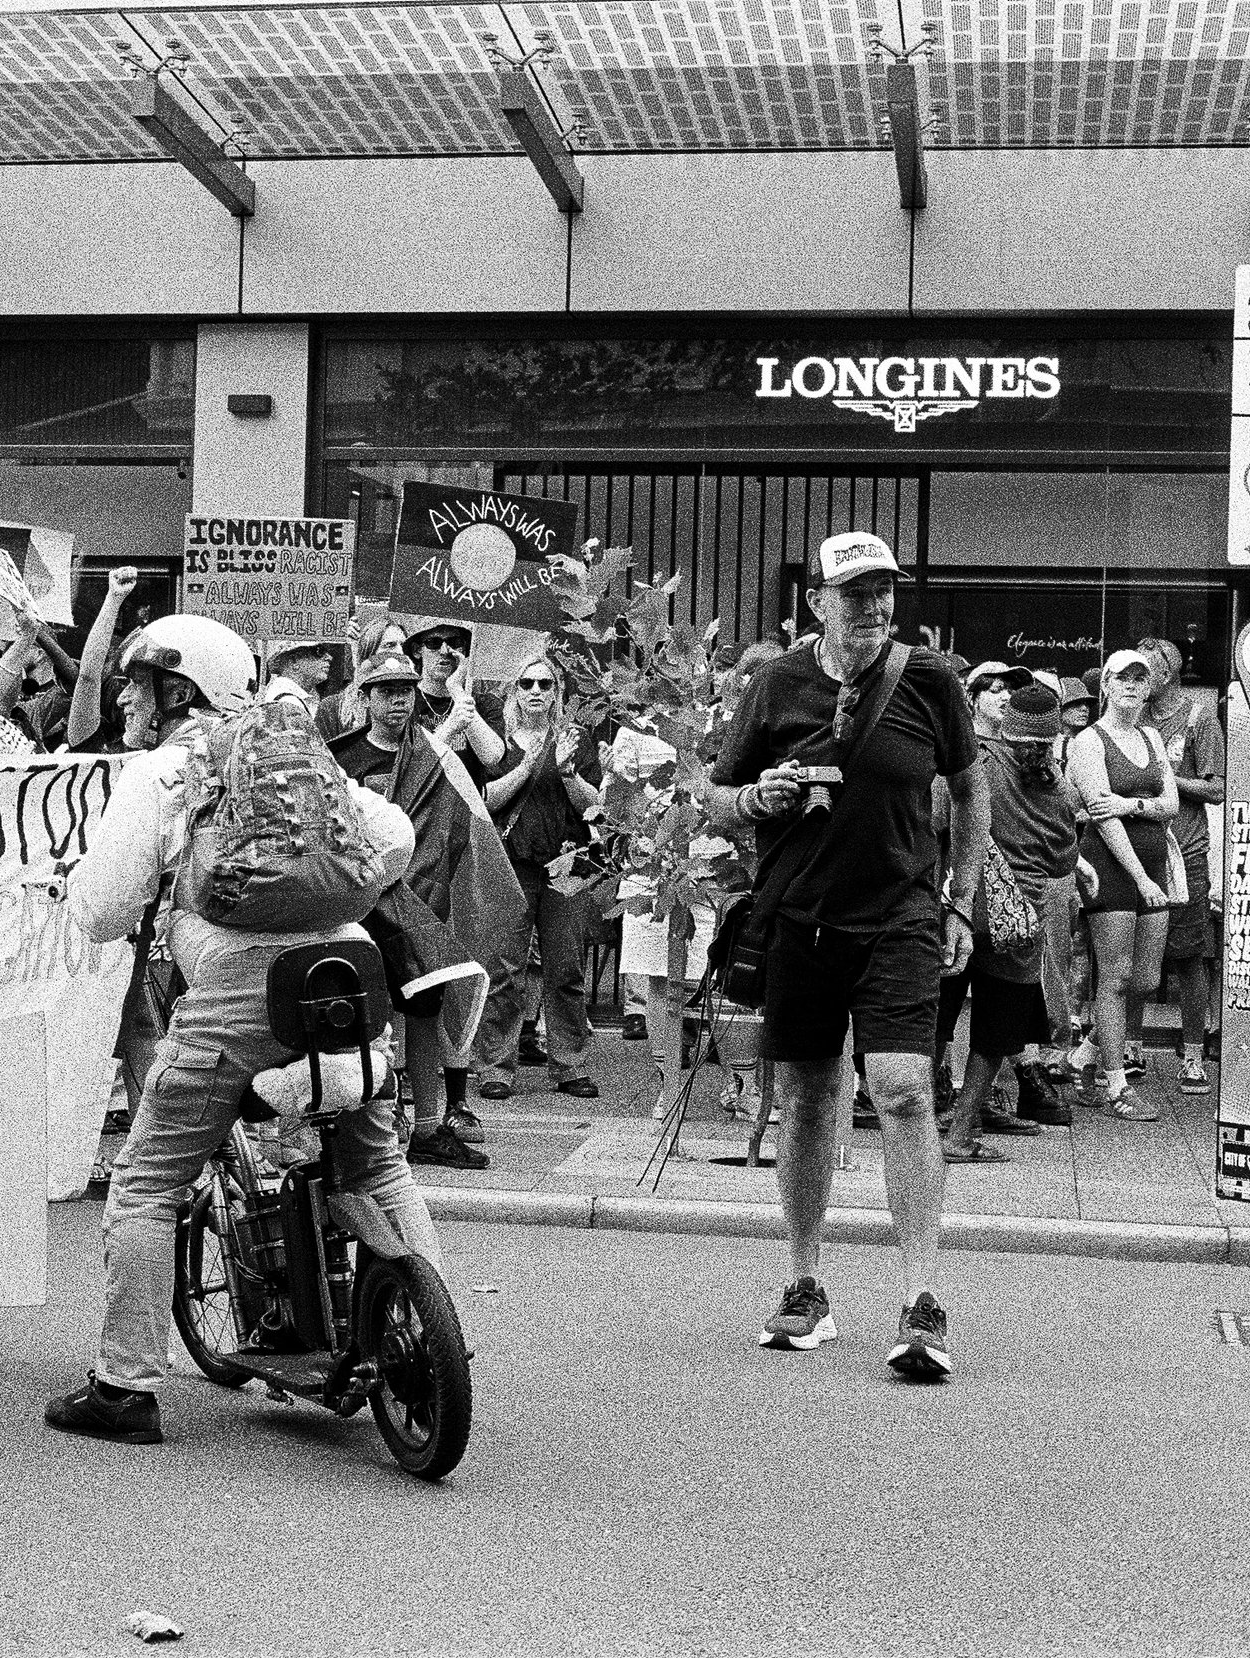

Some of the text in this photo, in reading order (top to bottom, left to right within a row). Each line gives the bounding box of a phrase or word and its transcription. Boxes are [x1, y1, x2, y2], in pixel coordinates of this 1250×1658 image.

[755, 357, 1060, 399] LONGINES
[189, 518, 344, 550] IGNORANCE
[429, 494, 556, 551] ALWAYS WAS
[186, 549, 211, 573] IS
[280, 550, 352, 577] RACIST
[205, 580, 335, 607] ALWAYS WAS
[415, 556, 498, 610] ALWAYS
[497, 575, 537, 606] WILL
[272, 610, 347, 637] WILL BE
